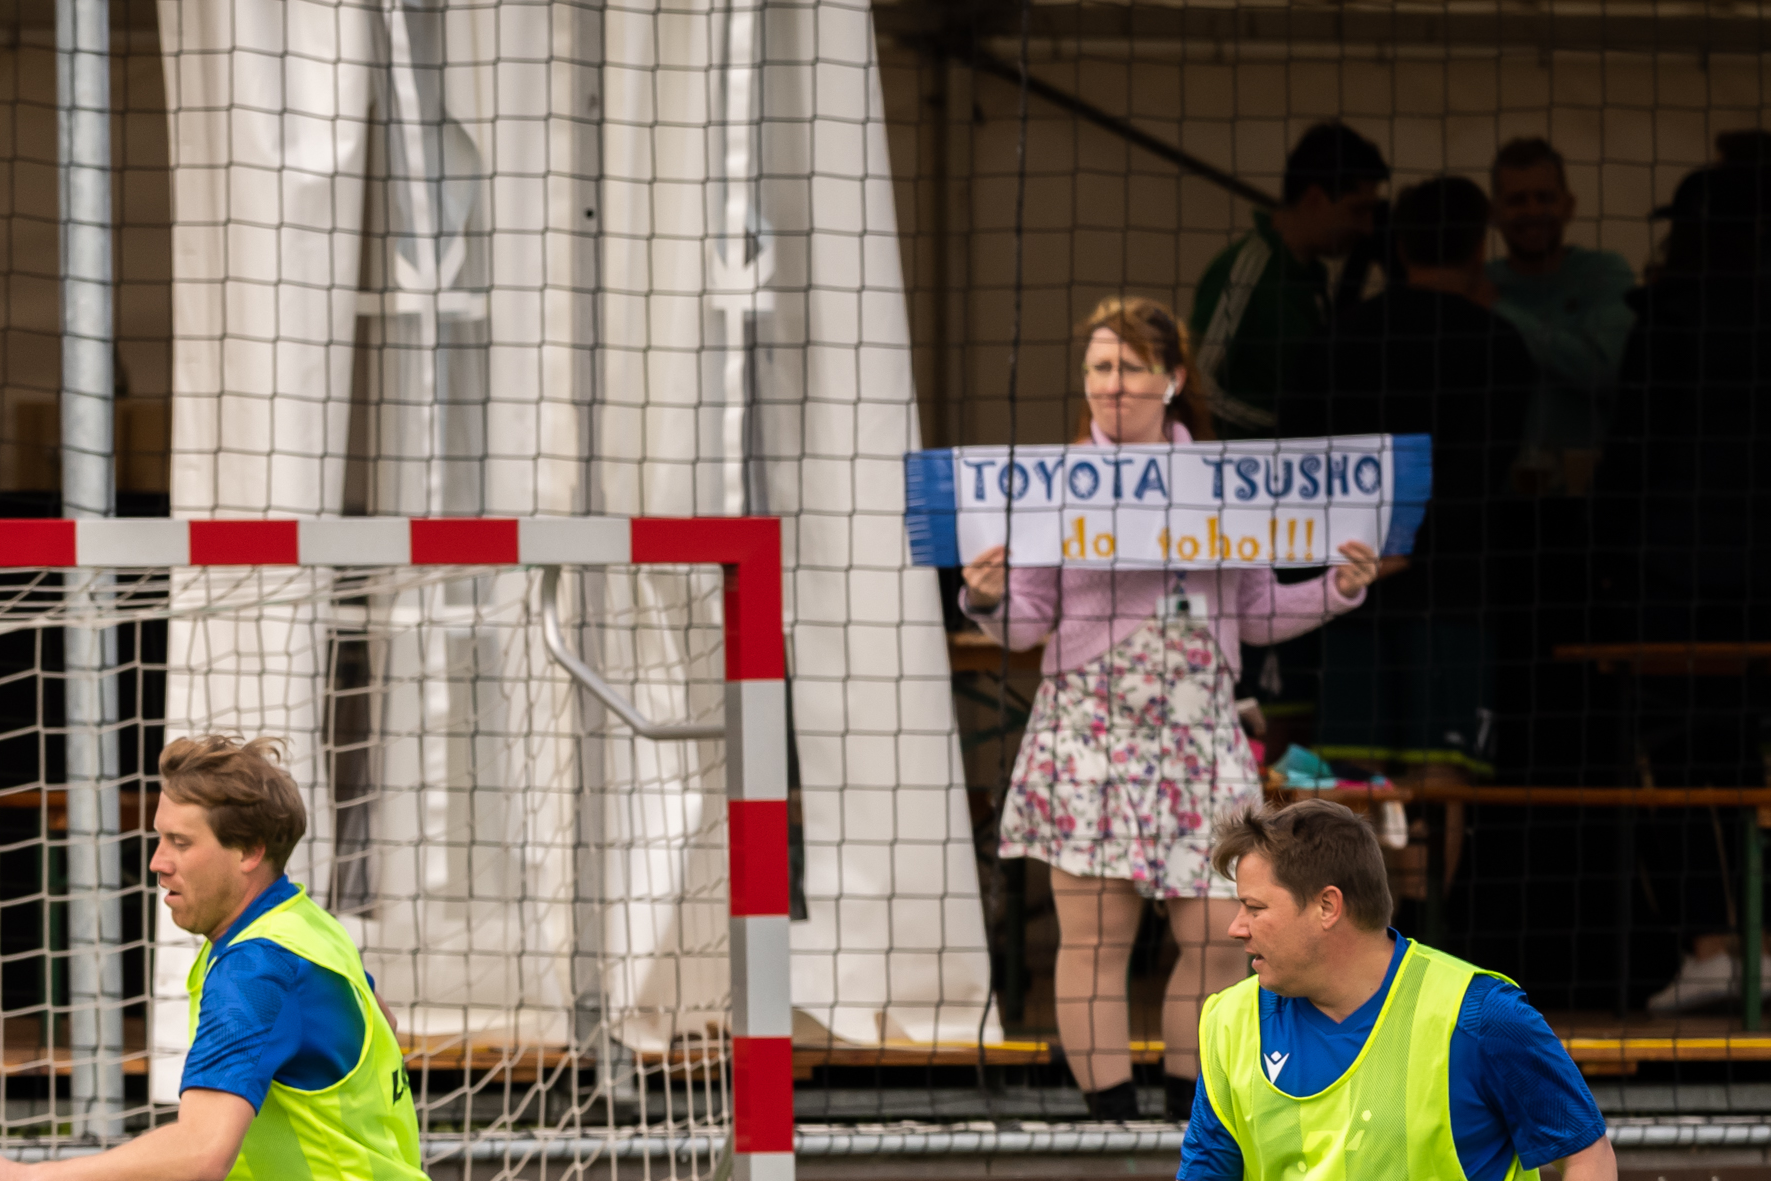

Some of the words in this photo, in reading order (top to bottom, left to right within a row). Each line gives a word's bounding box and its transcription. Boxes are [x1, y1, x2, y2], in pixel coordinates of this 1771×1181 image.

[963, 457, 1167, 502] TOYOTA
[1202, 454, 1382, 501] TSUSHO
[1063, 515, 1116, 560] do
